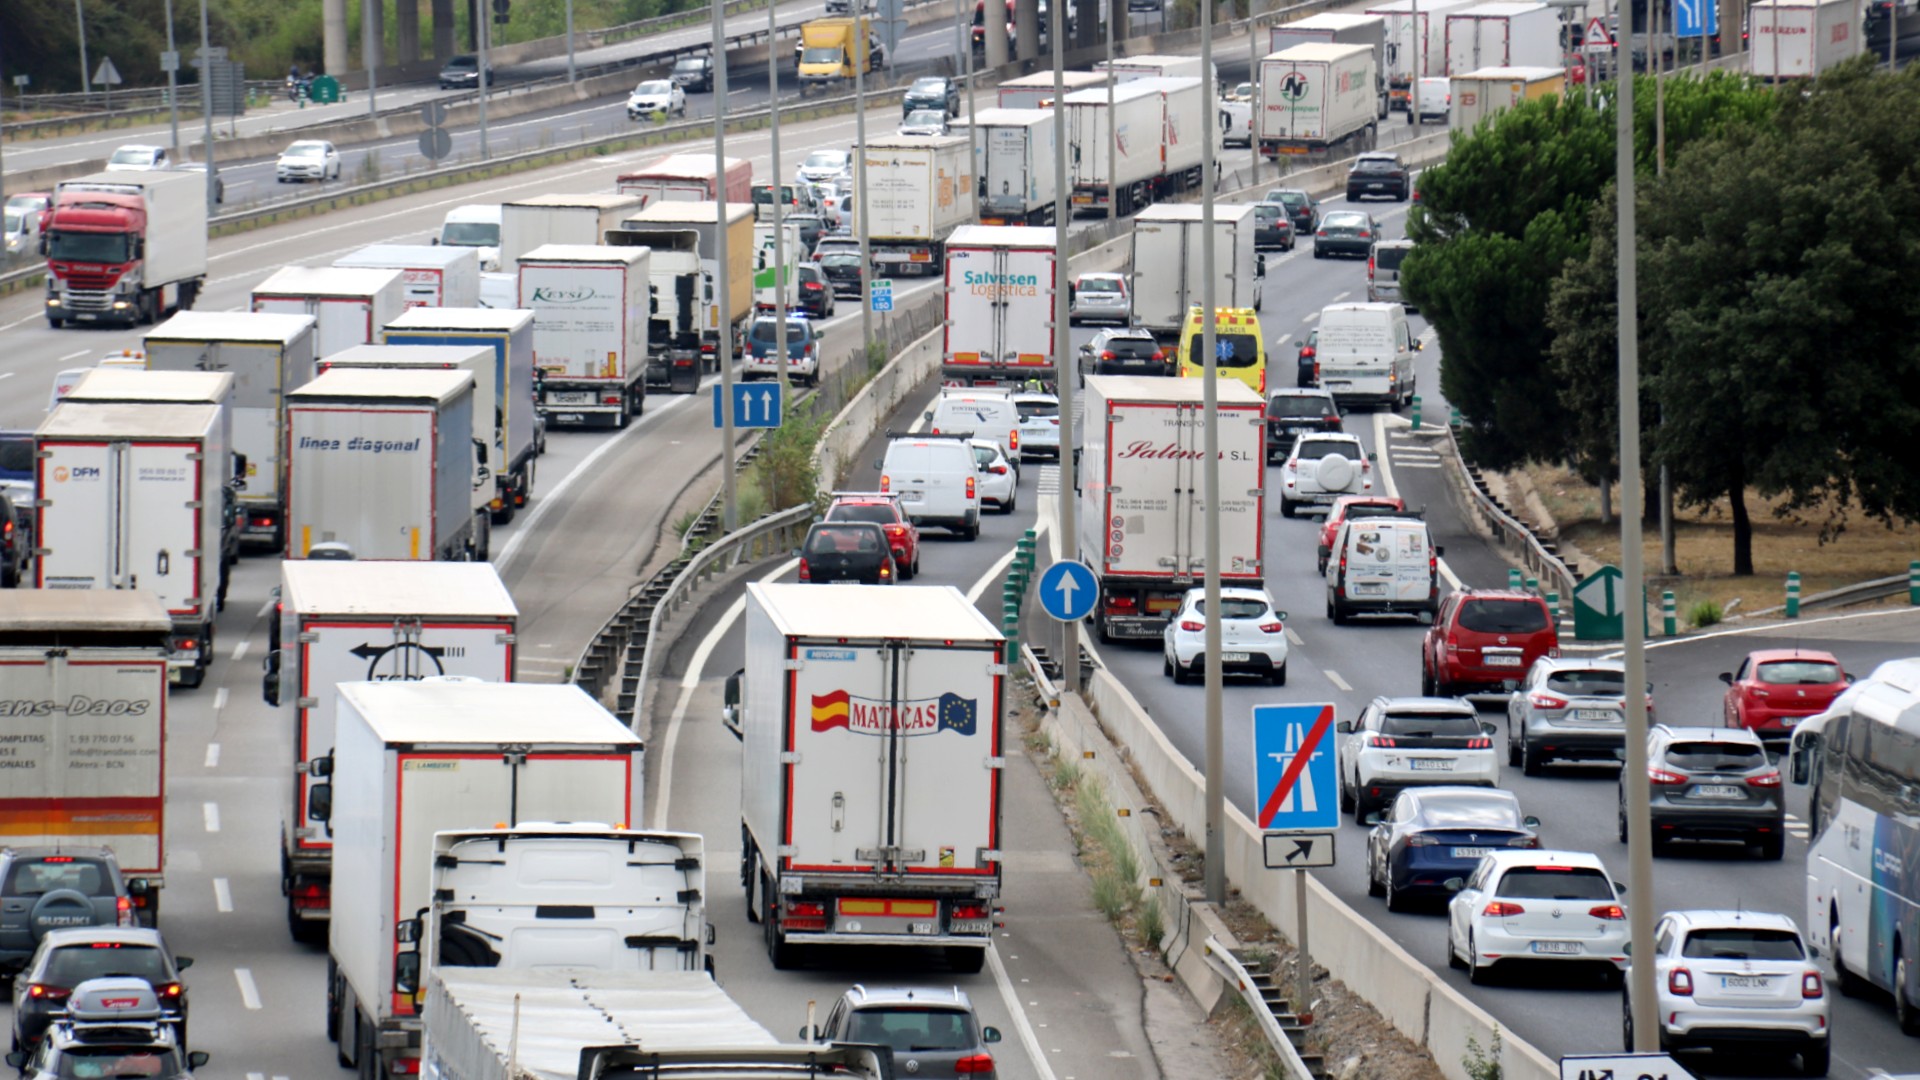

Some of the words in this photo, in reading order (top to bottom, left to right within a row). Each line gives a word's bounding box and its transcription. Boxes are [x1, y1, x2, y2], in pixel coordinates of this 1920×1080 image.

[964, 271, 1037, 285] Salvesen
[300, 437, 341, 449] linea
[347, 437, 421, 453] diagonal
[72, 467, 100, 477] DFM
[852, 704, 937, 729] MATACAS
[38, 916, 91, 925] SUZUKI
